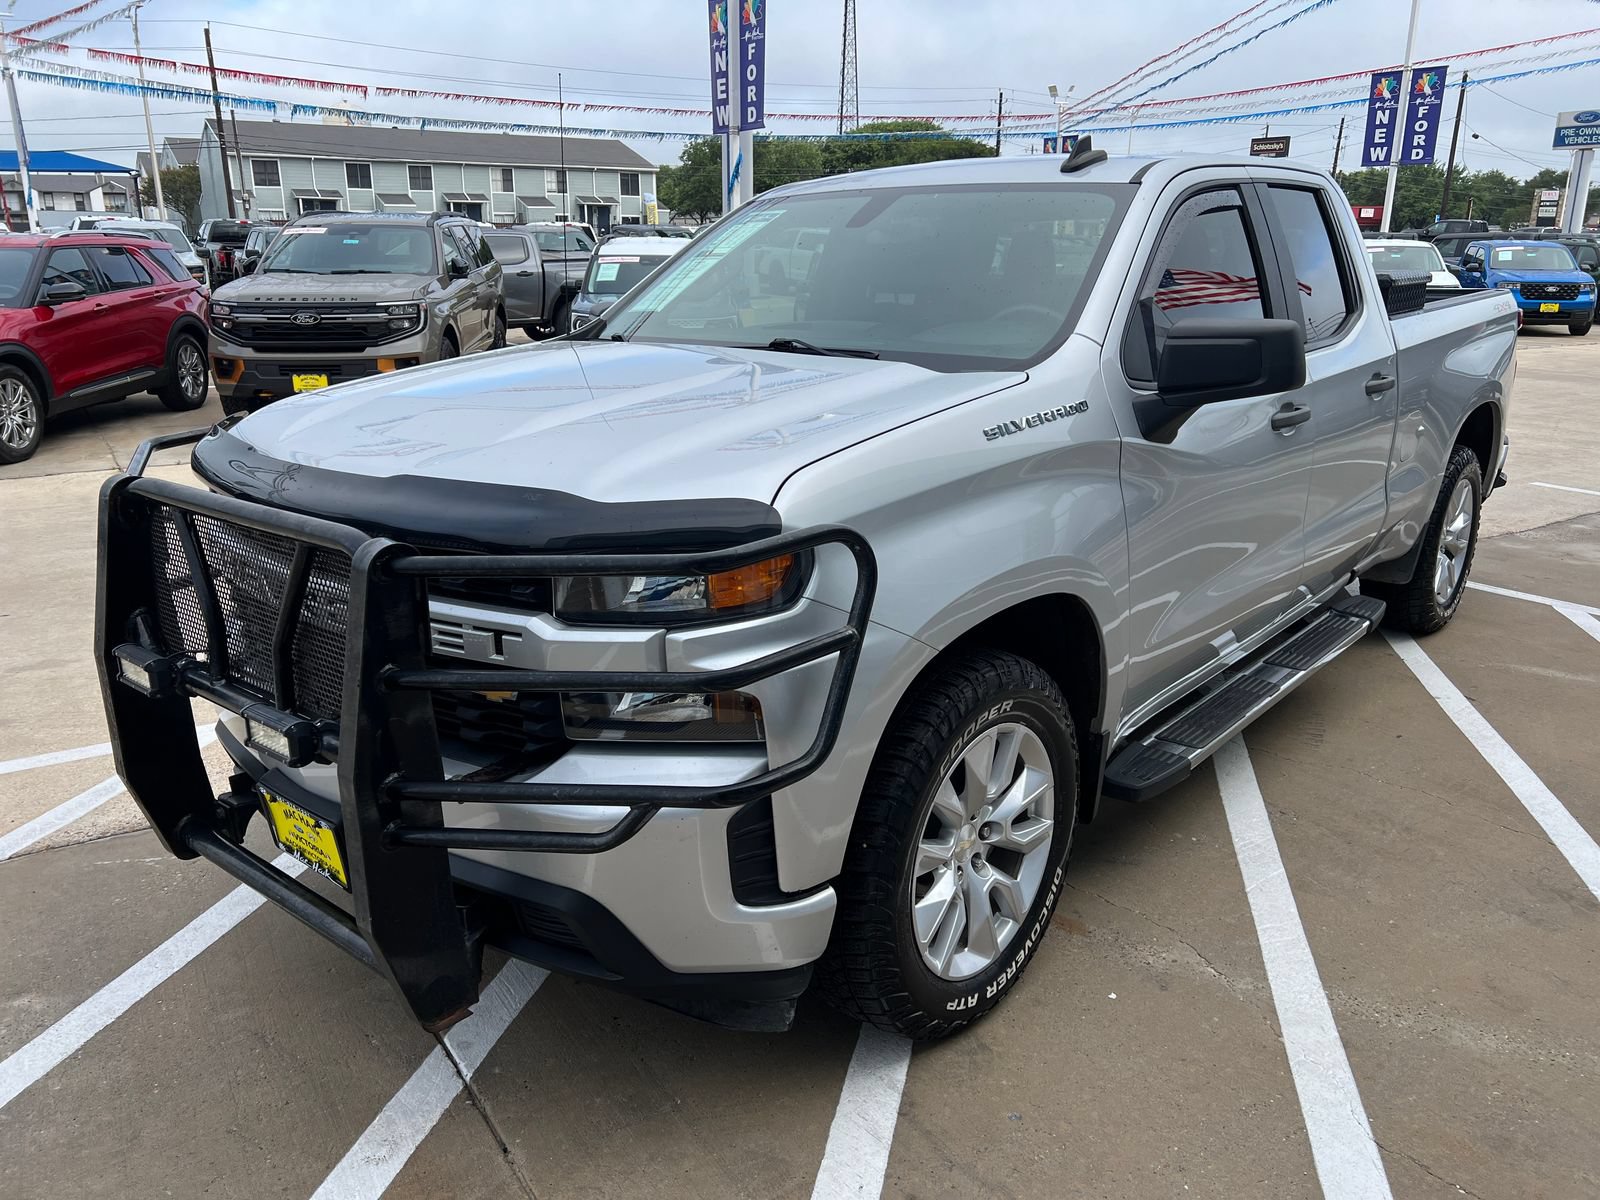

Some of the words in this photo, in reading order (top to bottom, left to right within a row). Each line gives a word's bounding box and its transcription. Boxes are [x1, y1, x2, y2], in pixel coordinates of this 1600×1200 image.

[715, 50, 729, 127] NEW
[746, 43, 757, 123] FORD
[1370, 110, 1389, 161] NEW
[1411, 106, 1429, 160] FORD
[1560, 127, 1600, 136] PRE-OWN
[982, 399, 1089, 441] SILVERADO
[940, 700, 1014, 777] COOPER
[986, 867, 1062, 998] DISCOVERER
[946, 993, 979, 1011] ATP
